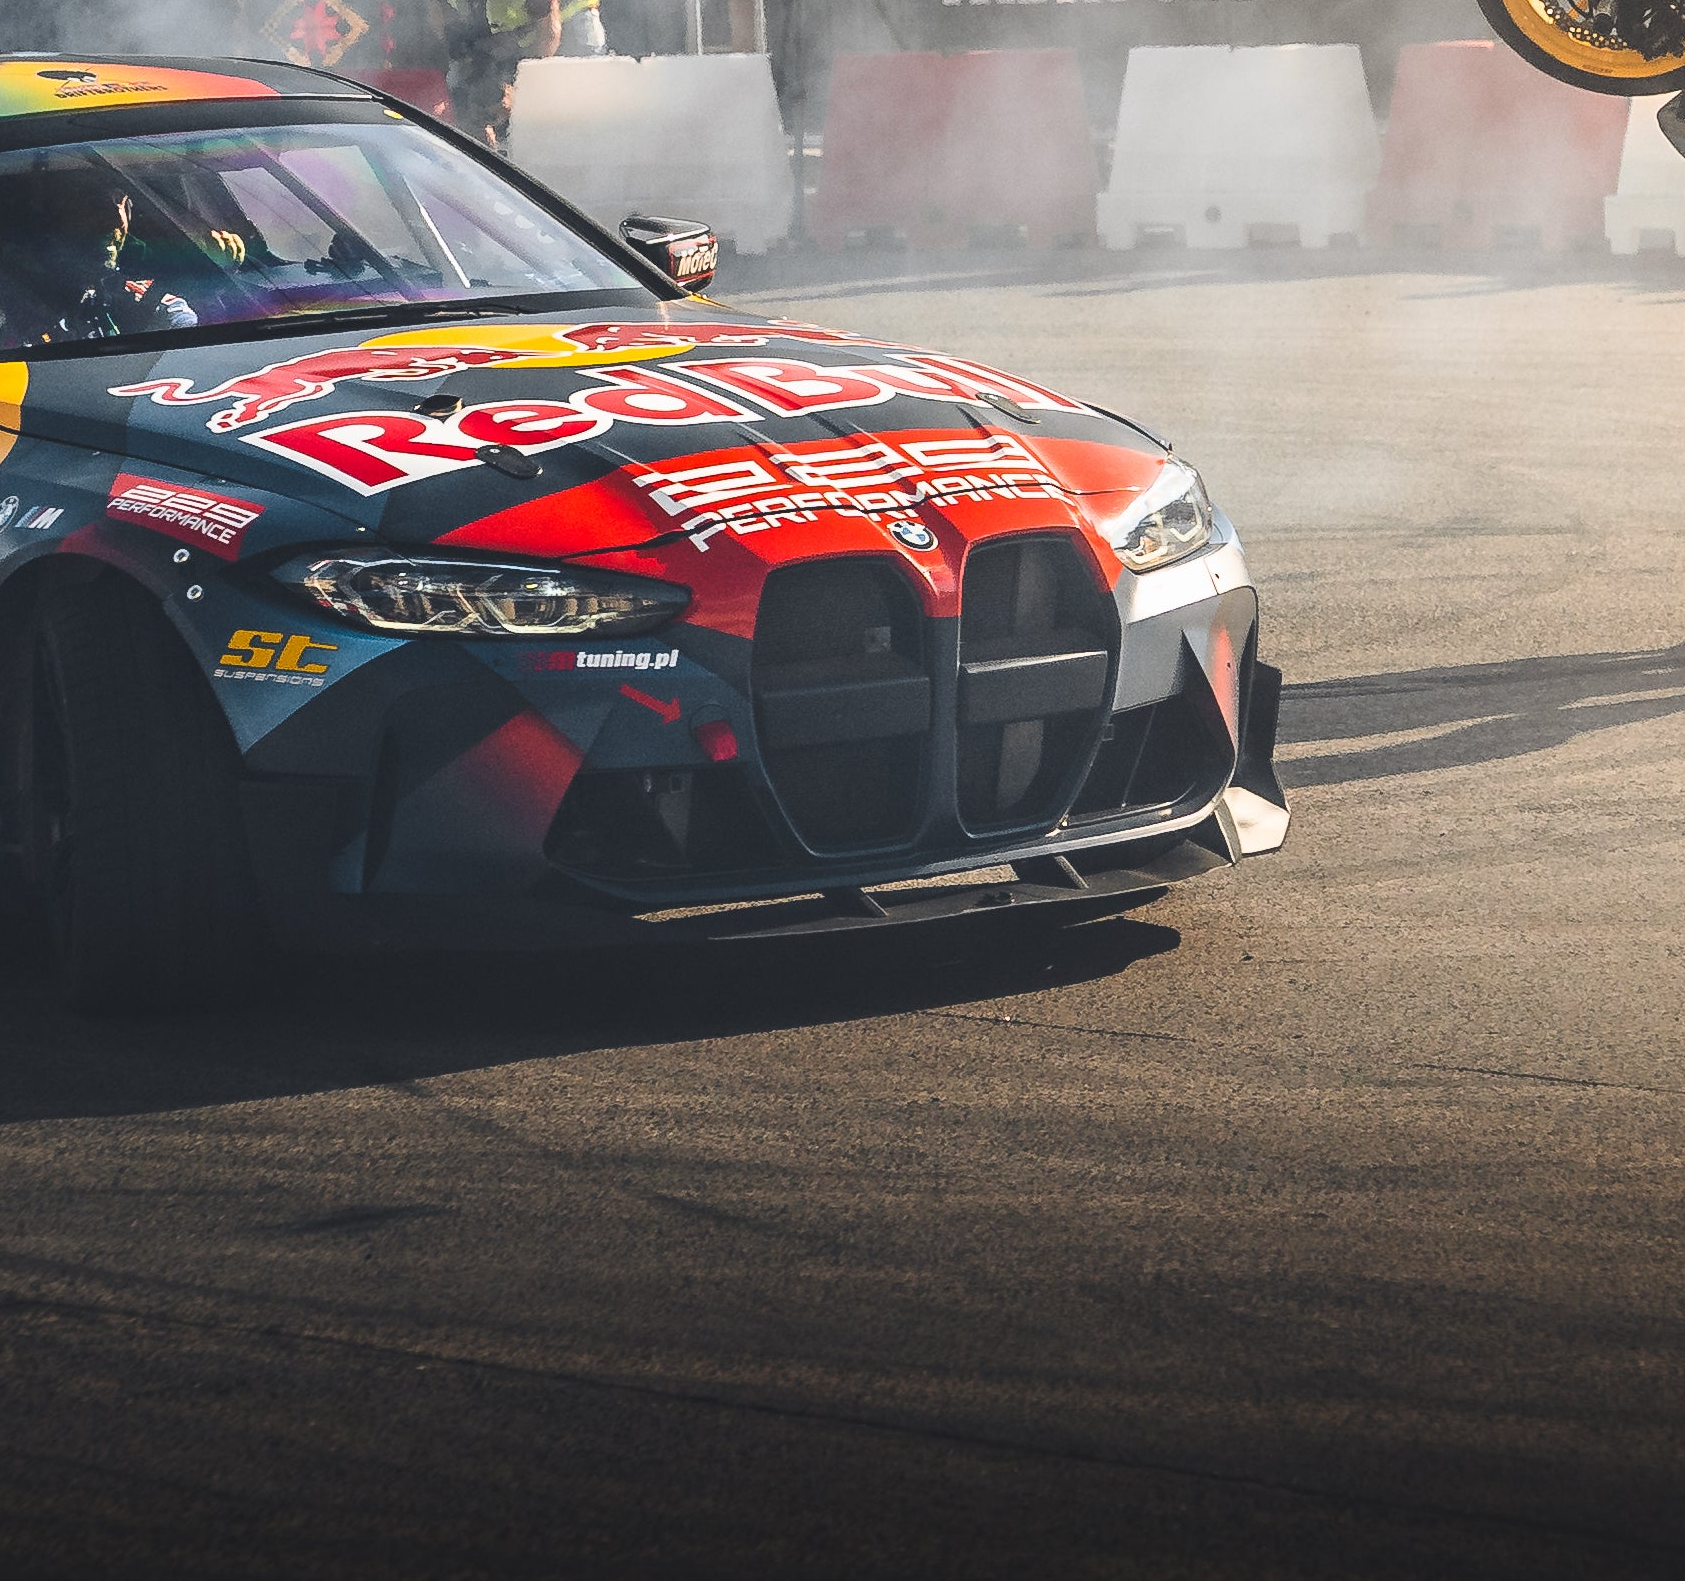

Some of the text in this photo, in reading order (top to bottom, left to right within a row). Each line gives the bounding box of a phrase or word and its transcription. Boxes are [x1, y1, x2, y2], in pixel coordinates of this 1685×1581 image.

[237, 353, 1103, 497] Red Bull
[107, 497, 237, 545] PERFORMANCE
[680, 471, 1077, 553] PERFORMANCE
